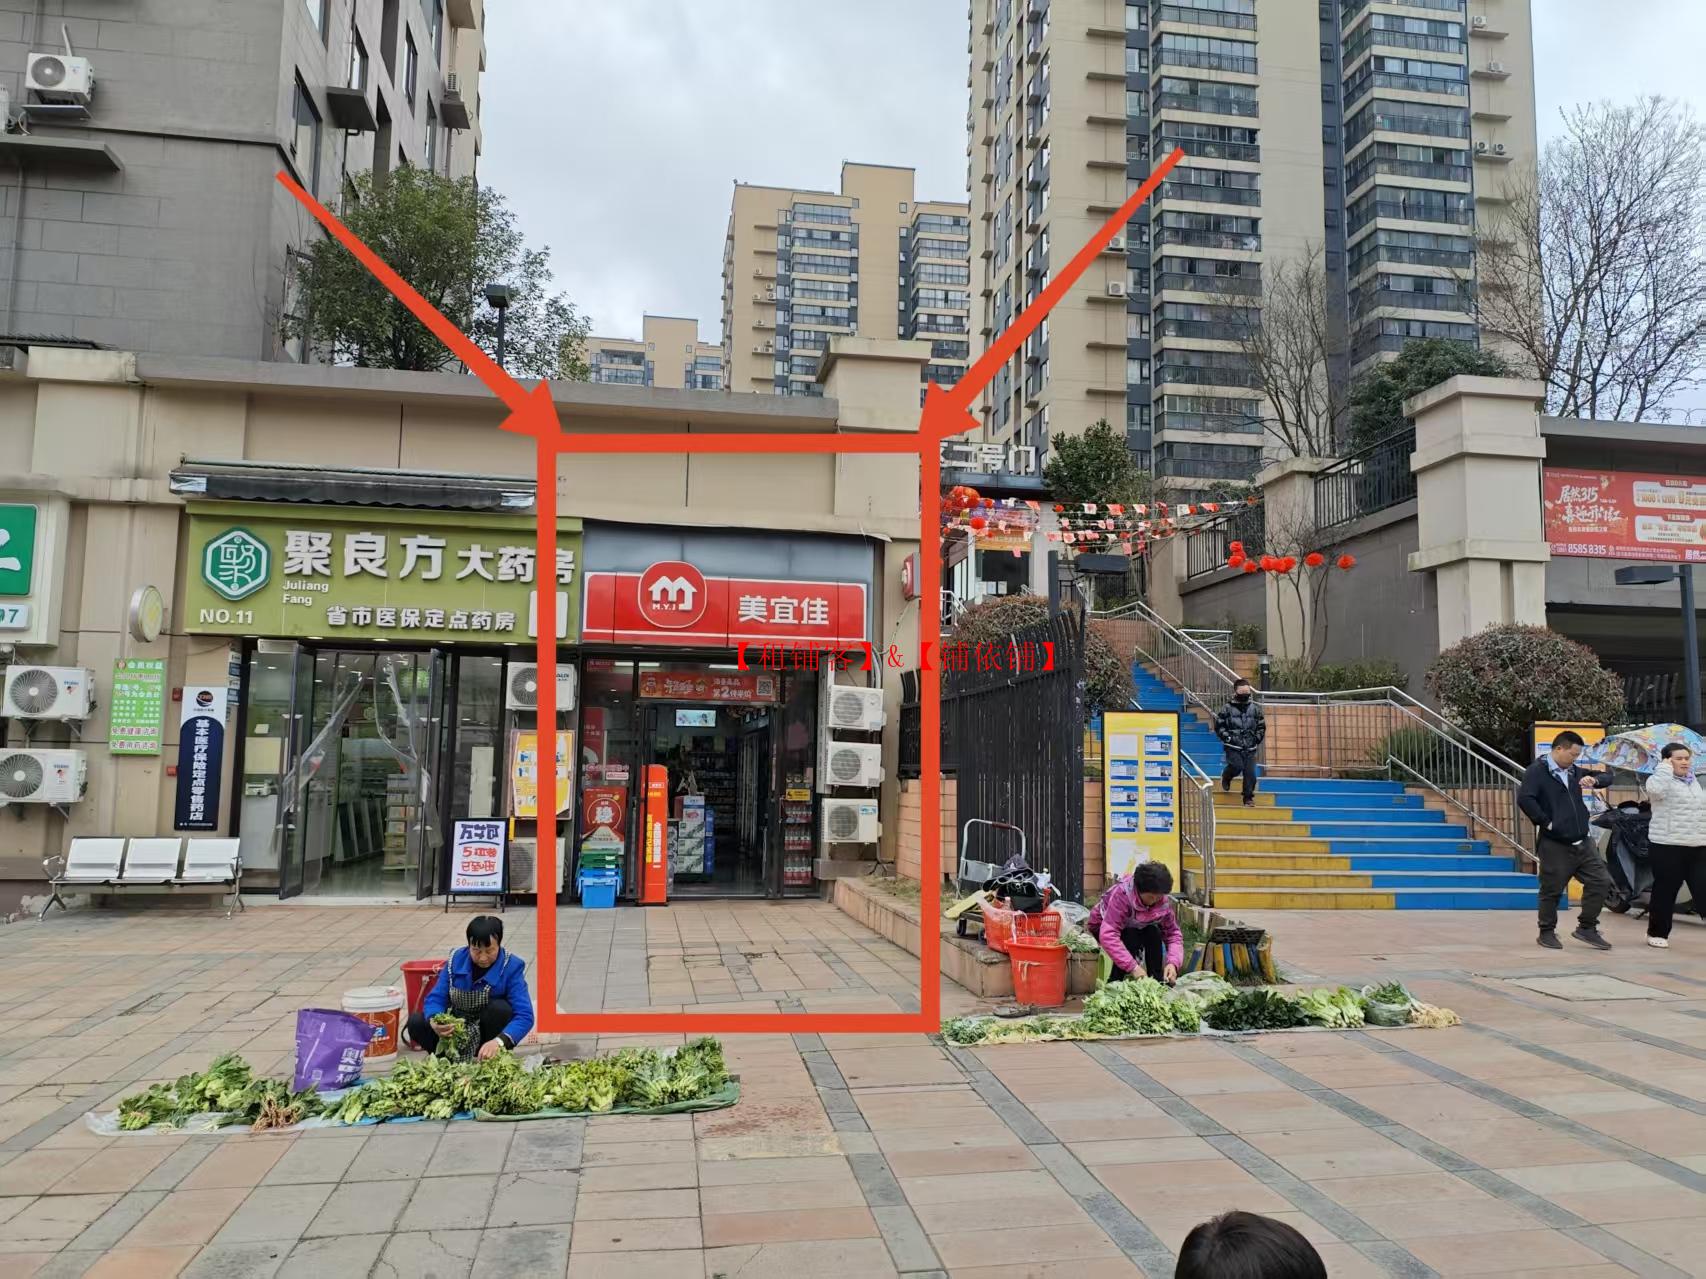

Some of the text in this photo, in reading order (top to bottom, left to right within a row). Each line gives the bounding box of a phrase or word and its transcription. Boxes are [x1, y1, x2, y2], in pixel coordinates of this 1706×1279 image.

[282, 580, 329, 593] Juliang
[282, 593, 313, 606] Fang
[200, 608, 252, 625] NO.11
[326, 605, 517, 632] 省市医保定点药房
[737, 595, 829, 625] 美宜佳
